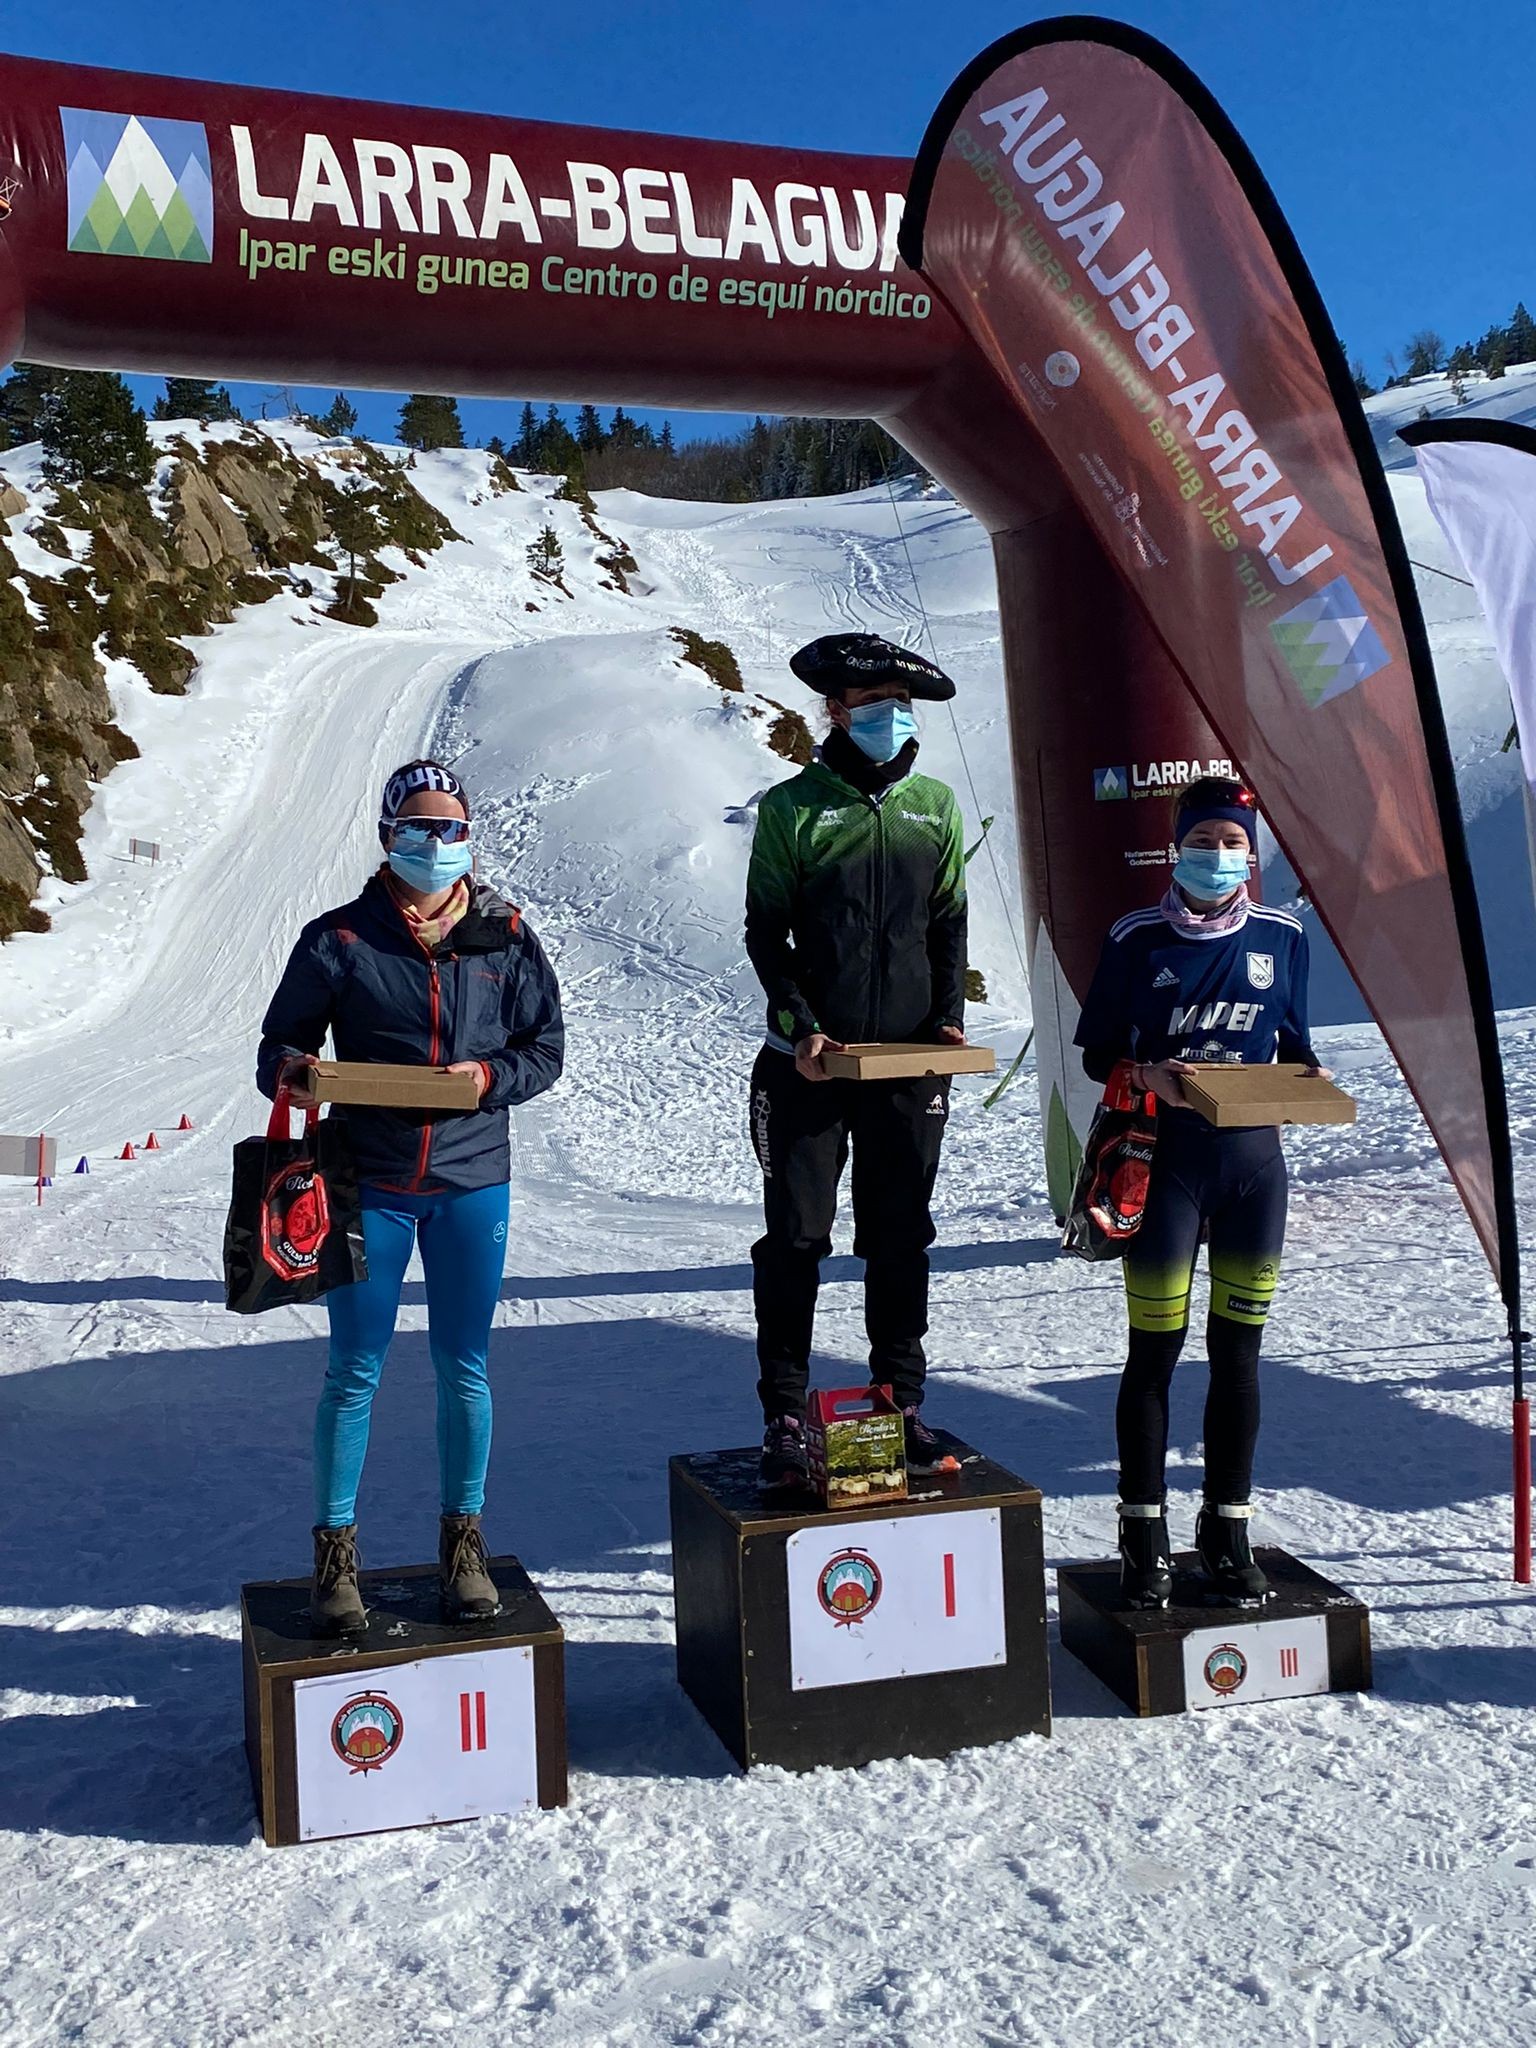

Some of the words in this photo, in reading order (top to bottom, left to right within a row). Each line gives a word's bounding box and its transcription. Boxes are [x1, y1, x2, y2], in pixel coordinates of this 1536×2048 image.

[239, 228, 316, 280] Ipar
[328, 238, 406, 281] eski
[416, 254, 530, 295] gunea
[541, 255, 658, 299] Centro
[668, 264, 709, 302] de
[718, 275, 806, 319] esquí
[814, 279, 932, 320] nórdico
[1132, 758, 1240, 788] LARRA-BEL
[1152, 976, 1181, 988] adidas
[1167, 1001, 1259, 1036] MAPEI
[460, 1691, 487, 1753] II
